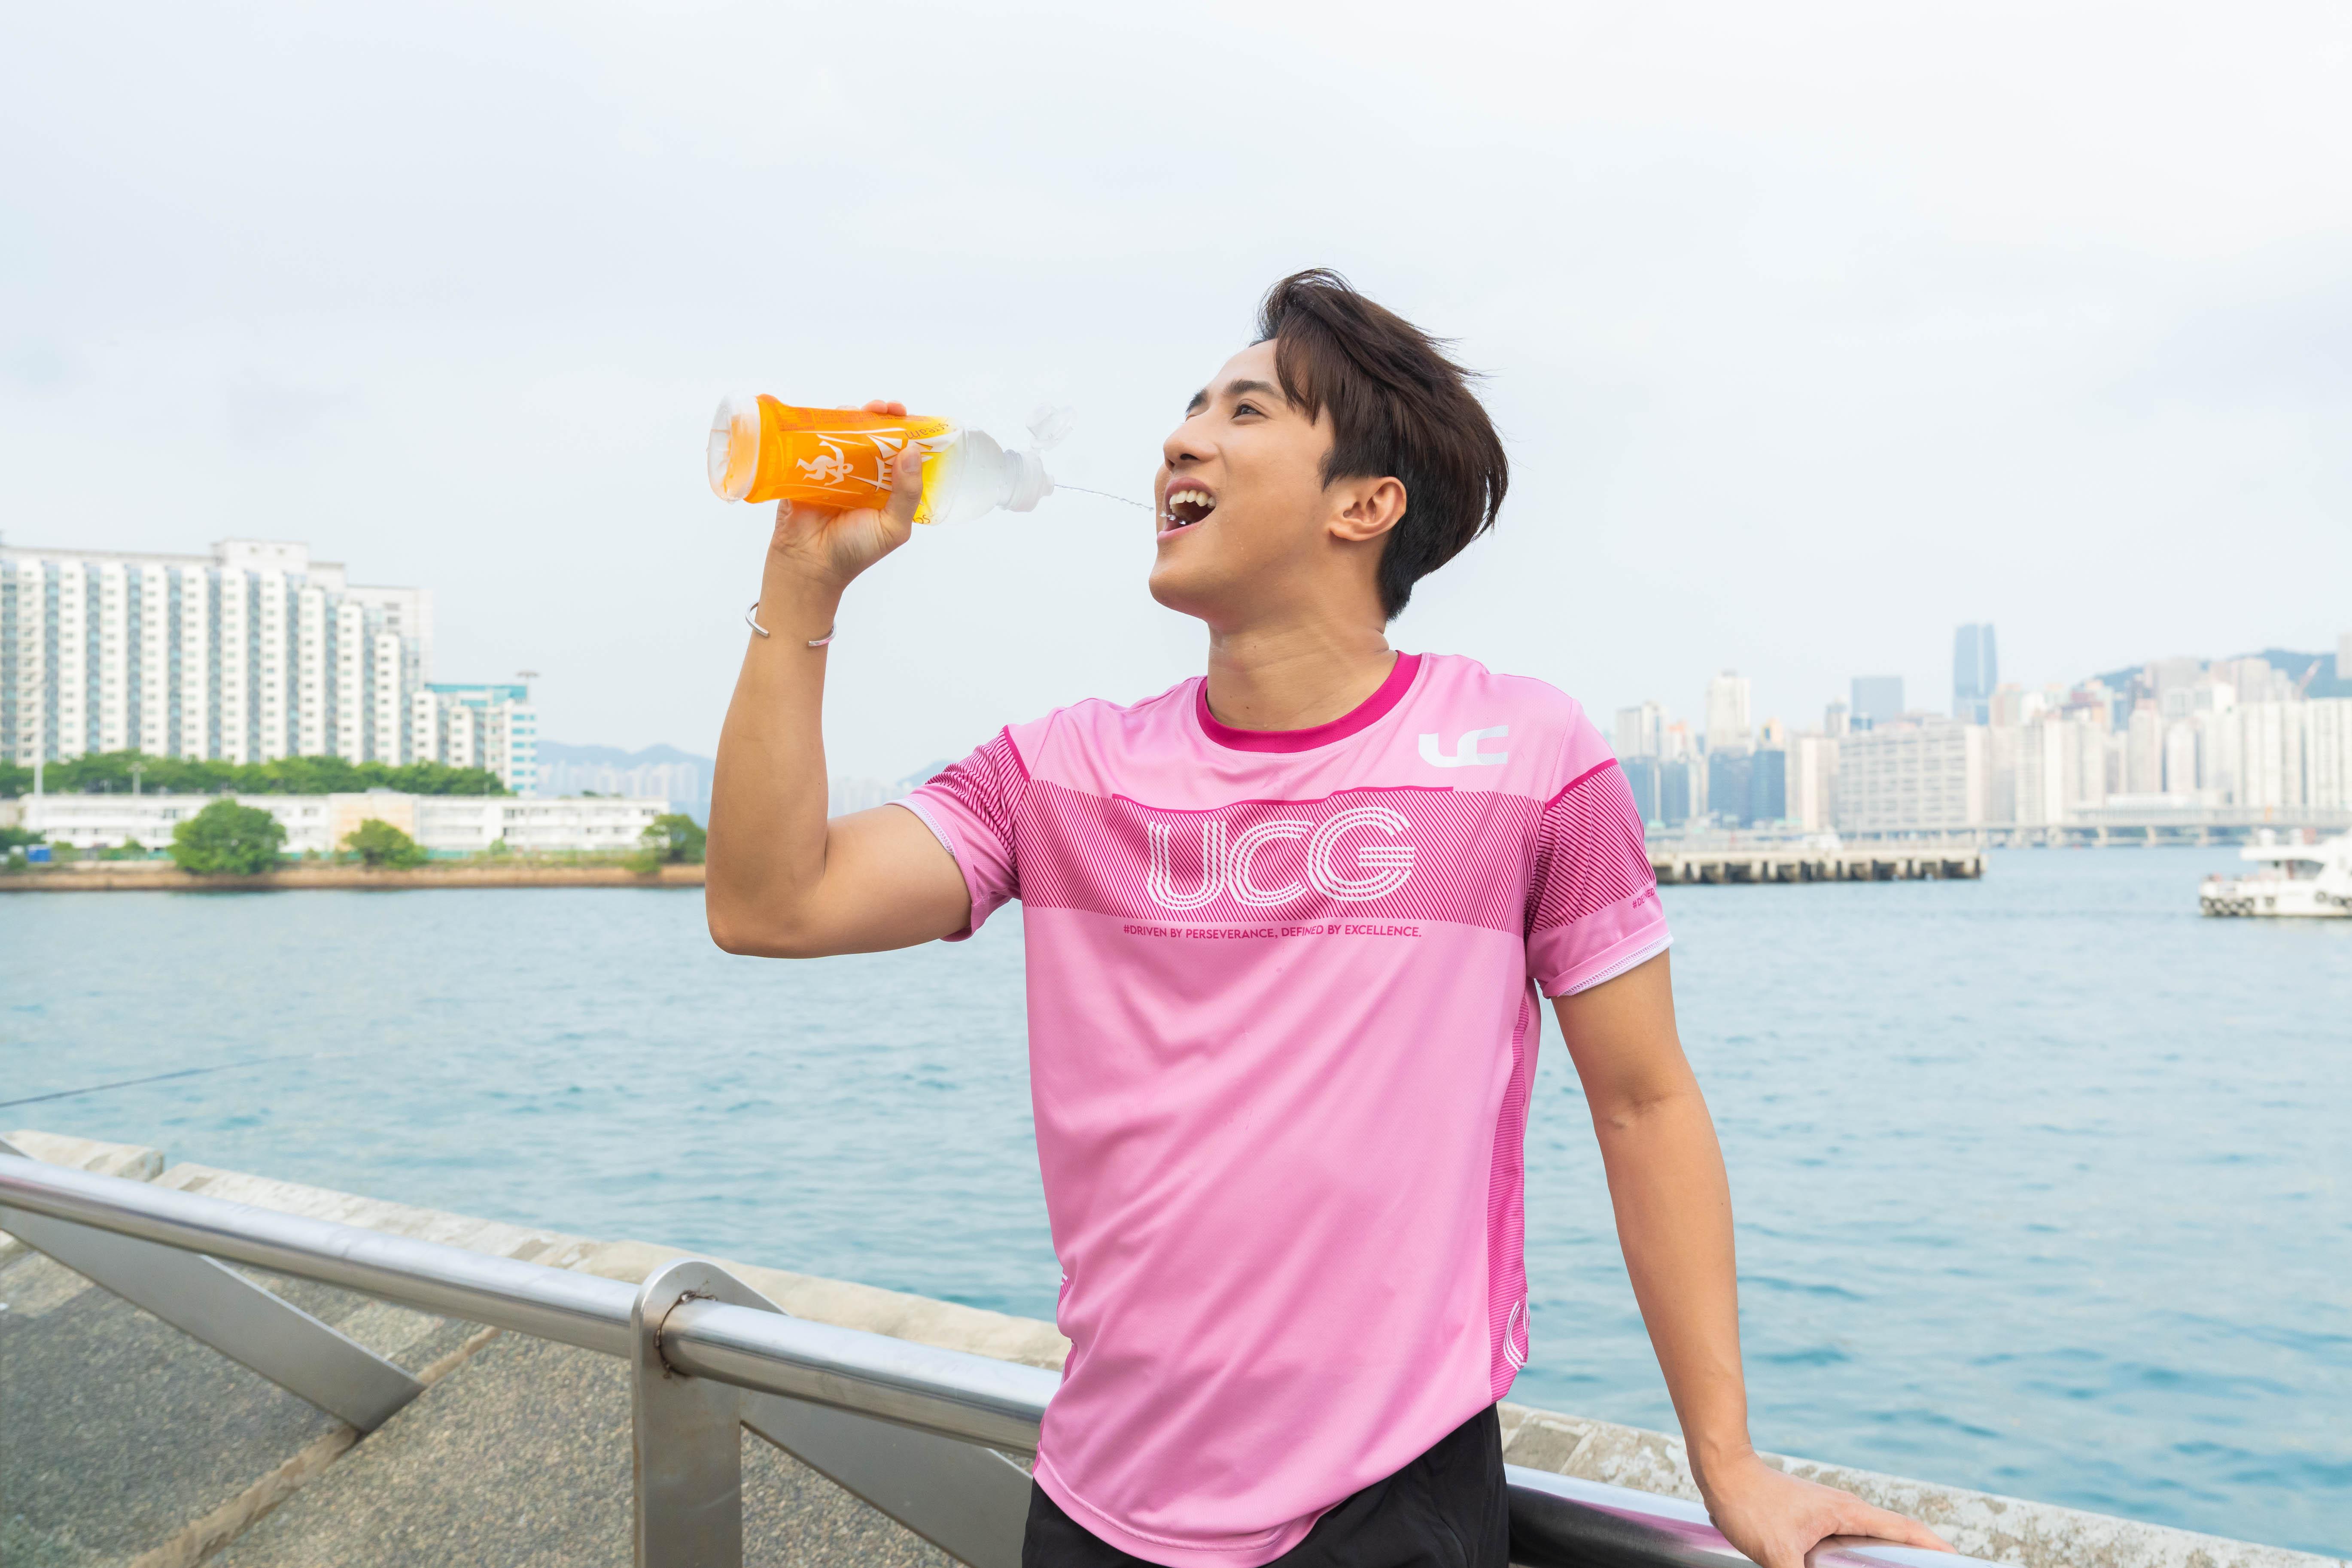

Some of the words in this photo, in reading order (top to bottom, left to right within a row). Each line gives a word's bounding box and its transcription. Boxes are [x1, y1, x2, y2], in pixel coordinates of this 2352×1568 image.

[904, 423, 949, 439] scream
[1147, 807, 1415, 910] UCG
[1123, 924, 1167, 937] #DRIVEN
[1170, 928, 1183, 938] BY
[1186, 928, 1278, 939] PERSEVERANCE,
[1281, 925, 1324, 937] DEFINED
[1327, 924, 1342, 935] BY
[1345, 924, 1422, 938] EXCELLENCE.
